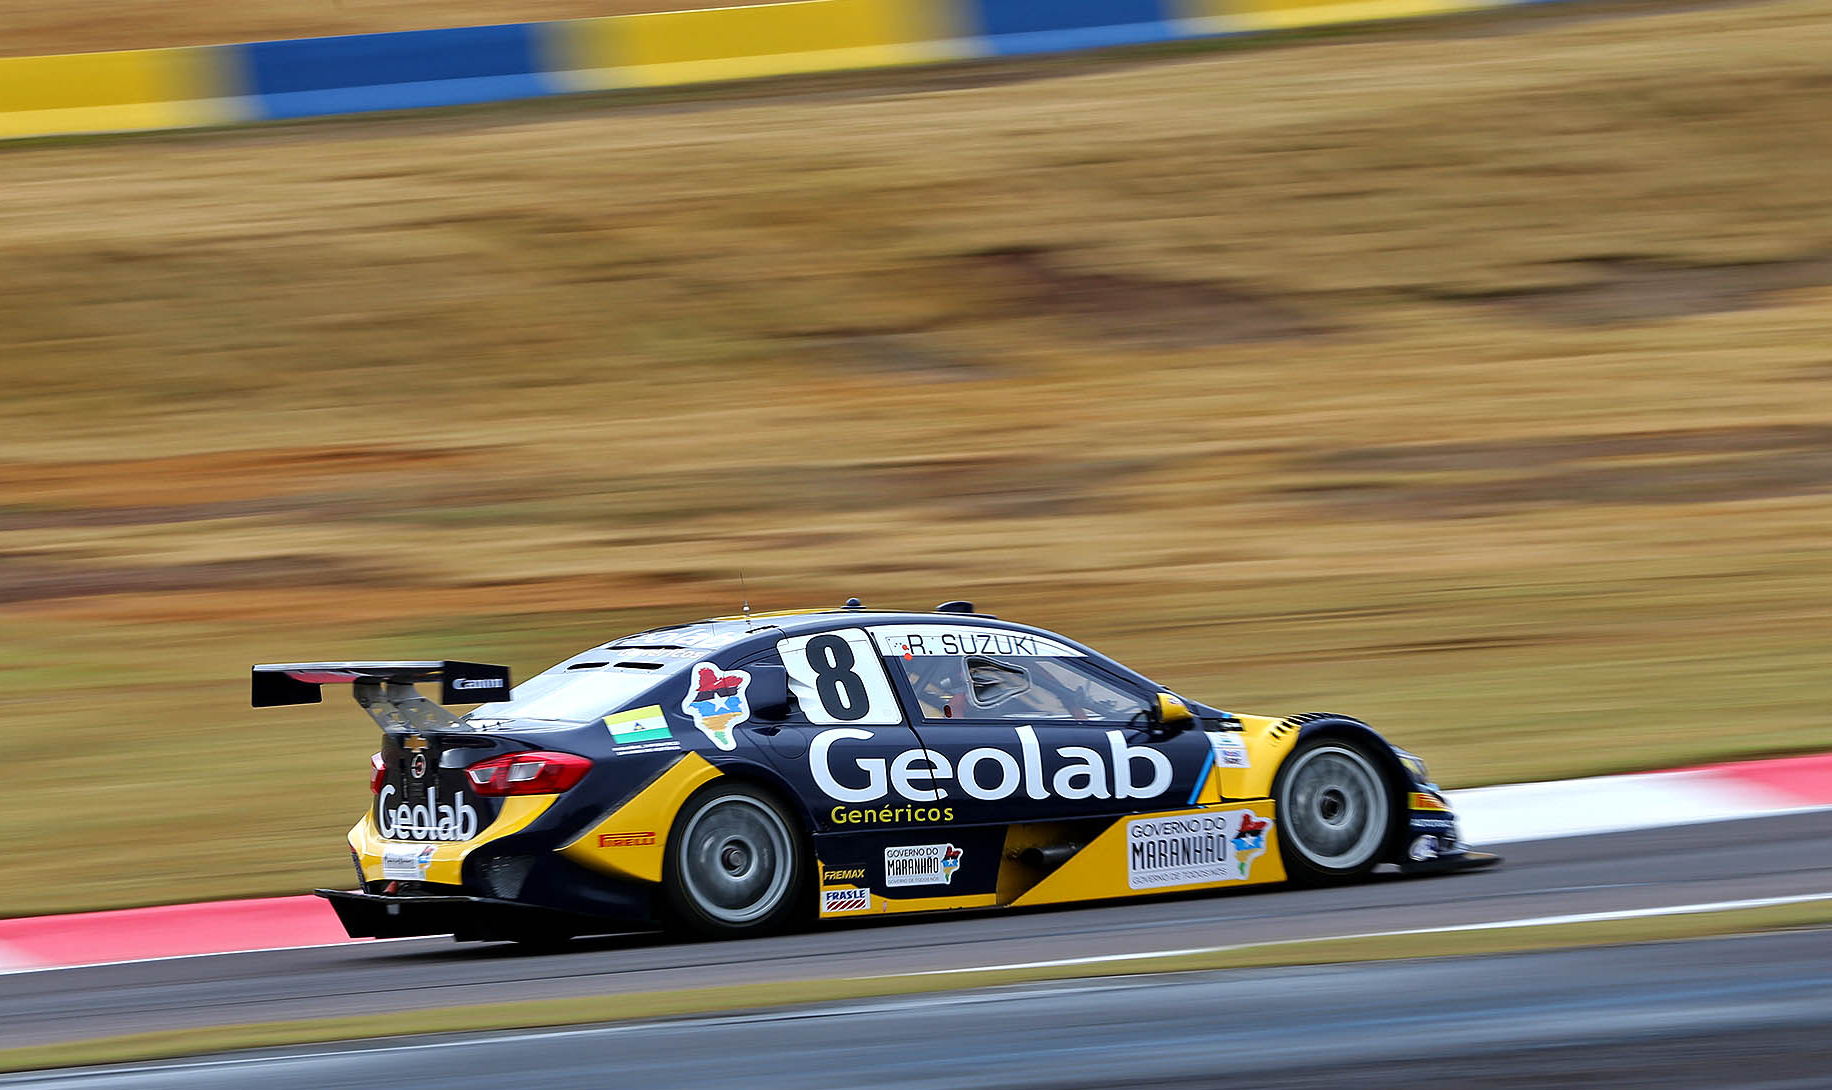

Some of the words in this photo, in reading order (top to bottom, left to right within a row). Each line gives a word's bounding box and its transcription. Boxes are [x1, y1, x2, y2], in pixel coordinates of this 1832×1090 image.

[907, 634, 934, 655] R.
[941, 634, 1038, 656] SUZUKI
[806, 634, 870, 720] 8
[809, 725, 1173, 802] Geolab
[380, 784, 478, 841] Geolab
[831, 804, 954, 824] Genéricos
[1131, 819, 1201, 838] GOVERNO
[1203, 816, 1227, 831] DO
[598, 831, 656, 848] PIRELLI
[887, 848, 925, 858] GOVERNO
[926, 847, 939, 856] DO
[1131, 832, 1227, 871] MARANHÃO
[824, 869, 866, 881] FREMAX
[887, 856, 939, 876] MARANHÃO
